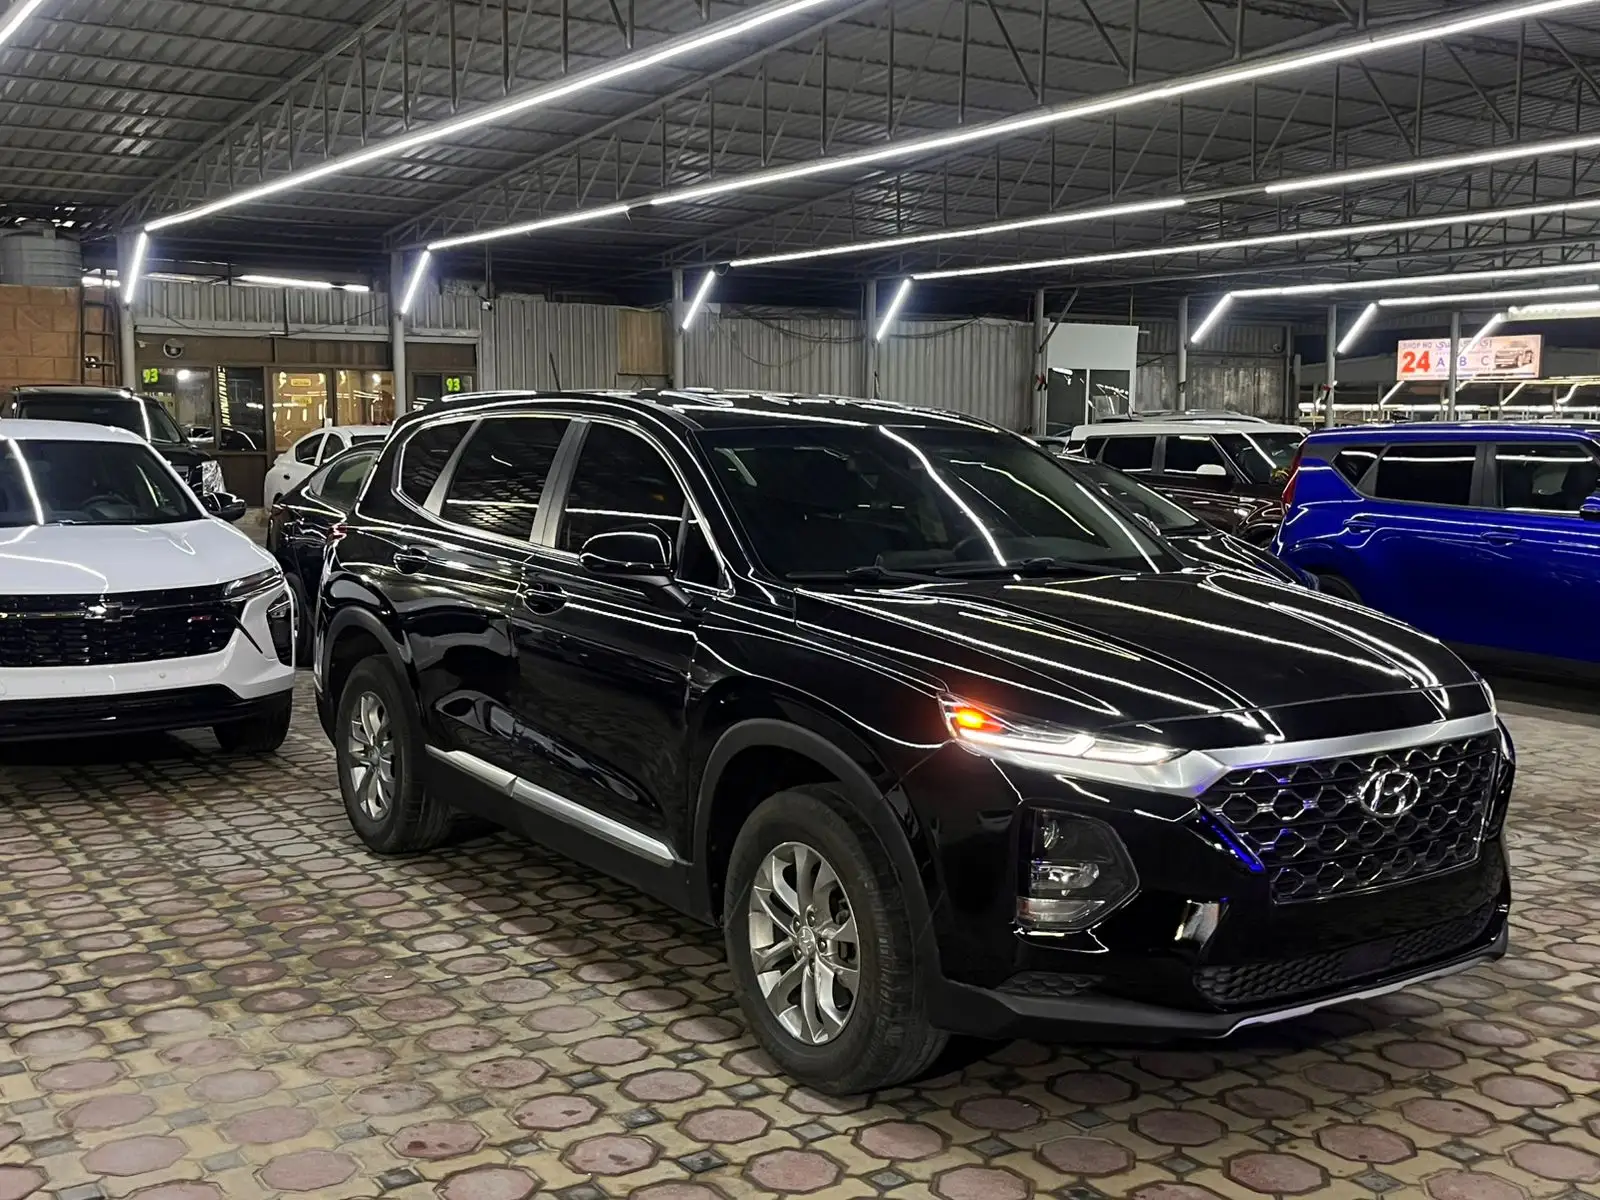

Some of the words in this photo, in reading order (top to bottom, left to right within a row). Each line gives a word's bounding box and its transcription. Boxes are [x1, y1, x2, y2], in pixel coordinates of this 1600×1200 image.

[1402, 350, 1430, 373] 24
[1436, 357, 1445, 367] A
[1459, 356, 1467, 366] B
[1481, 355, 1490, 366] C
[143, 368, 159, 384] 93
[446, 377, 461, 392] 93
